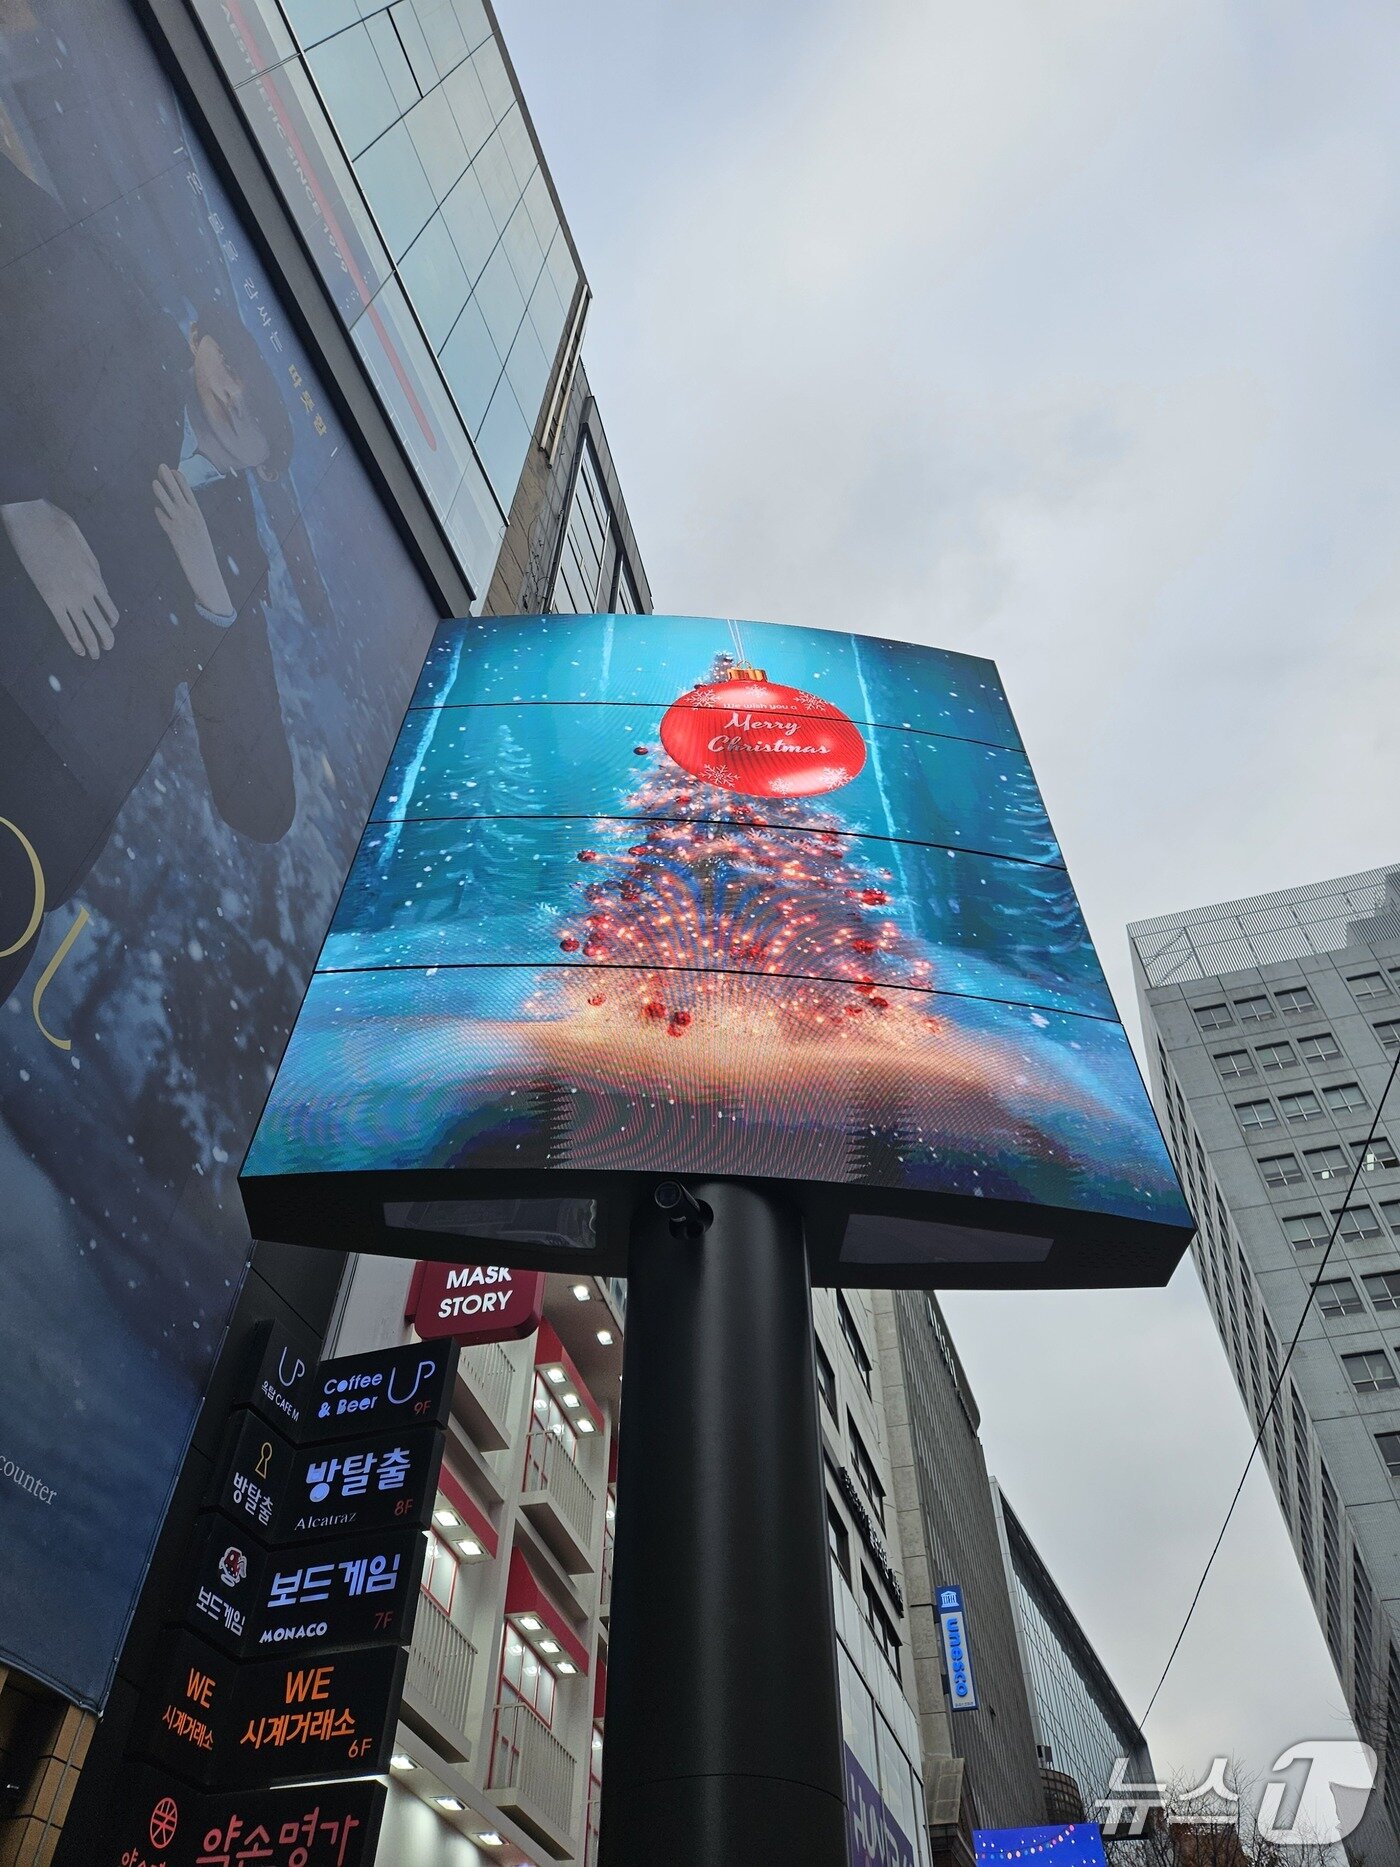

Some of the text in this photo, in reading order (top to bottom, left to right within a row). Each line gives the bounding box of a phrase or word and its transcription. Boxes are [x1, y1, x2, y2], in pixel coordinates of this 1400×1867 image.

[244, 277, 284, 353] 감싸는
[288, 363, 328, 437] 따뜻함
[724, 712, 801, 736] Merry
[707, 734, 831, 754] Christmas
[446, 1265, 512, 1290] MASK
[438, 1290, 513, 1318] STORY
[323, 1373, 383, 1395] Coffee
[275, 1394, 293, 1416] CAFE
[291, 1411, 300, 1422] M
[318, 1396, 379, 1419] & Beer
[413, 1400, 432, 1415] 9F
[305, 1447, 412, 1502] 방탈출
[232, 1472, 274, 1526] 방탈출
[394, 1499, 414, 1517] 8F
[294, 1512, 358, 1530] Alcatraz
[267, 1553, 400, 1608] 보드게임
[195, 1586, 246, 1636] 보드게임
[373, 1611, 394, 1631] 7F
[259, 1622, 328, 1644] MONACO
[946, 1617, 968, 1697] unesco
[186, 1667, 216, 1709] WE
[284, 1666, 335, 1704] WE
[162, 1704, 214, 1750] 시계거래소
[239, 1708, 356, 1750] 시계거래소
[348, 1738, 373, 1758] 6F
